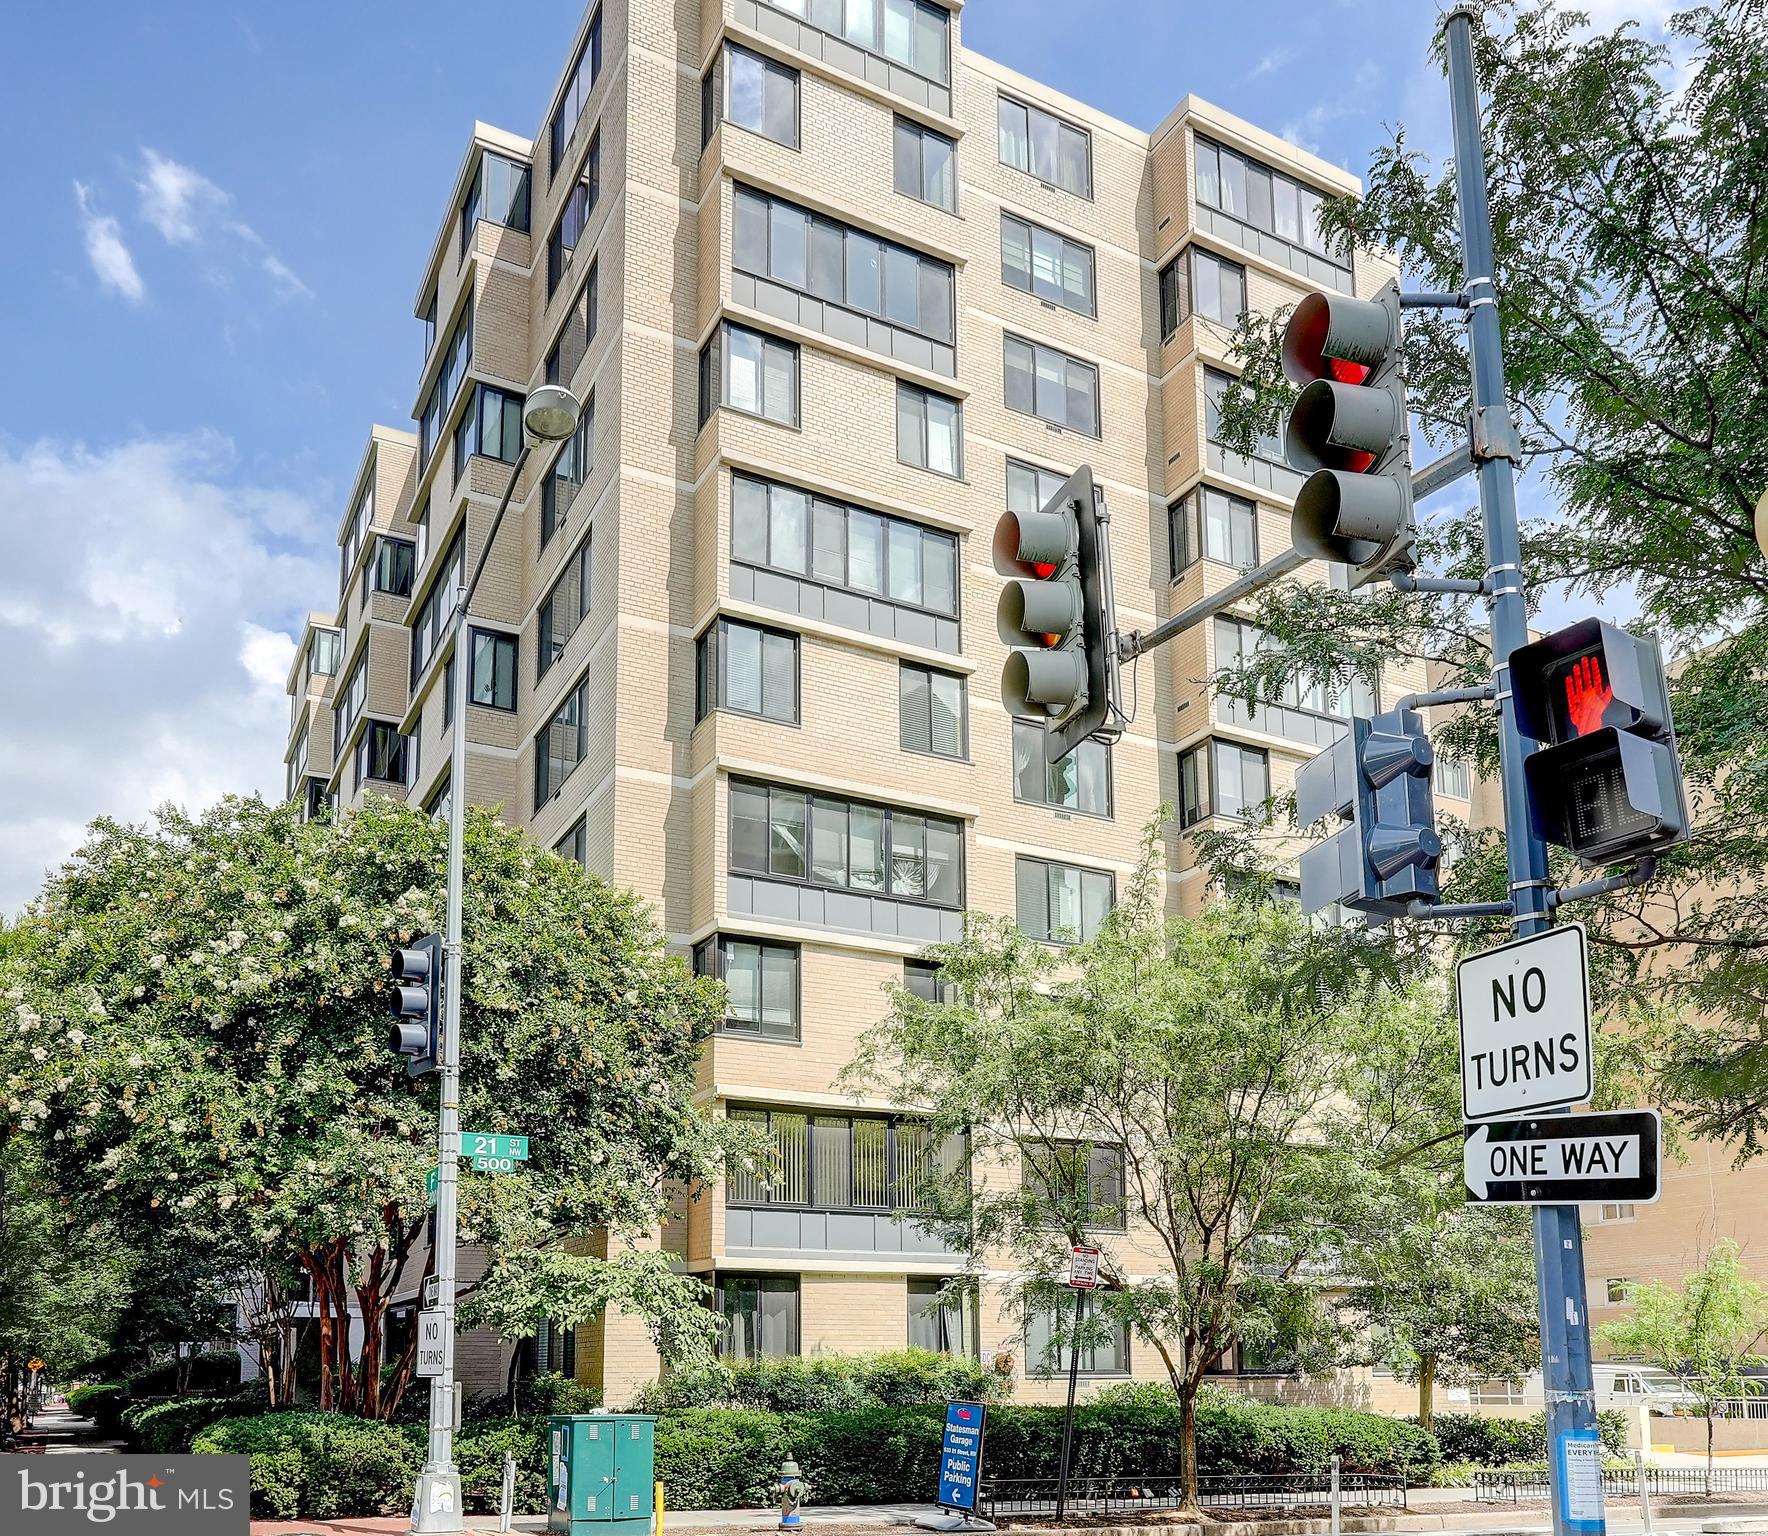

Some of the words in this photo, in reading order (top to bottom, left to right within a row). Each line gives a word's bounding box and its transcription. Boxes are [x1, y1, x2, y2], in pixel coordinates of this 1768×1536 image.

[1491, 966, 1546, 1022] NO
[1471, 1033, 1579, 1090] TURNS
[474, 1136, 497, 1155] 21
[509, 1139, 522, 1147] ST
[509, 1148, 522, 1156] NW
[1490, 1144, 1548, 1177] ONE
[1561, 1140, 1629, 1175] WAY
[477, 1158, 511, 1171] 500
[425, 1322, 439, 1340] NO
[420, 1350, 443, 1365] TURNS
[946, 1423, 979, 1435] Statesman
[950, 1434, 973, 1447] Garage
[947, 1459, 971, 1471] Public
[944, 1471, 971, 1487] Parking
